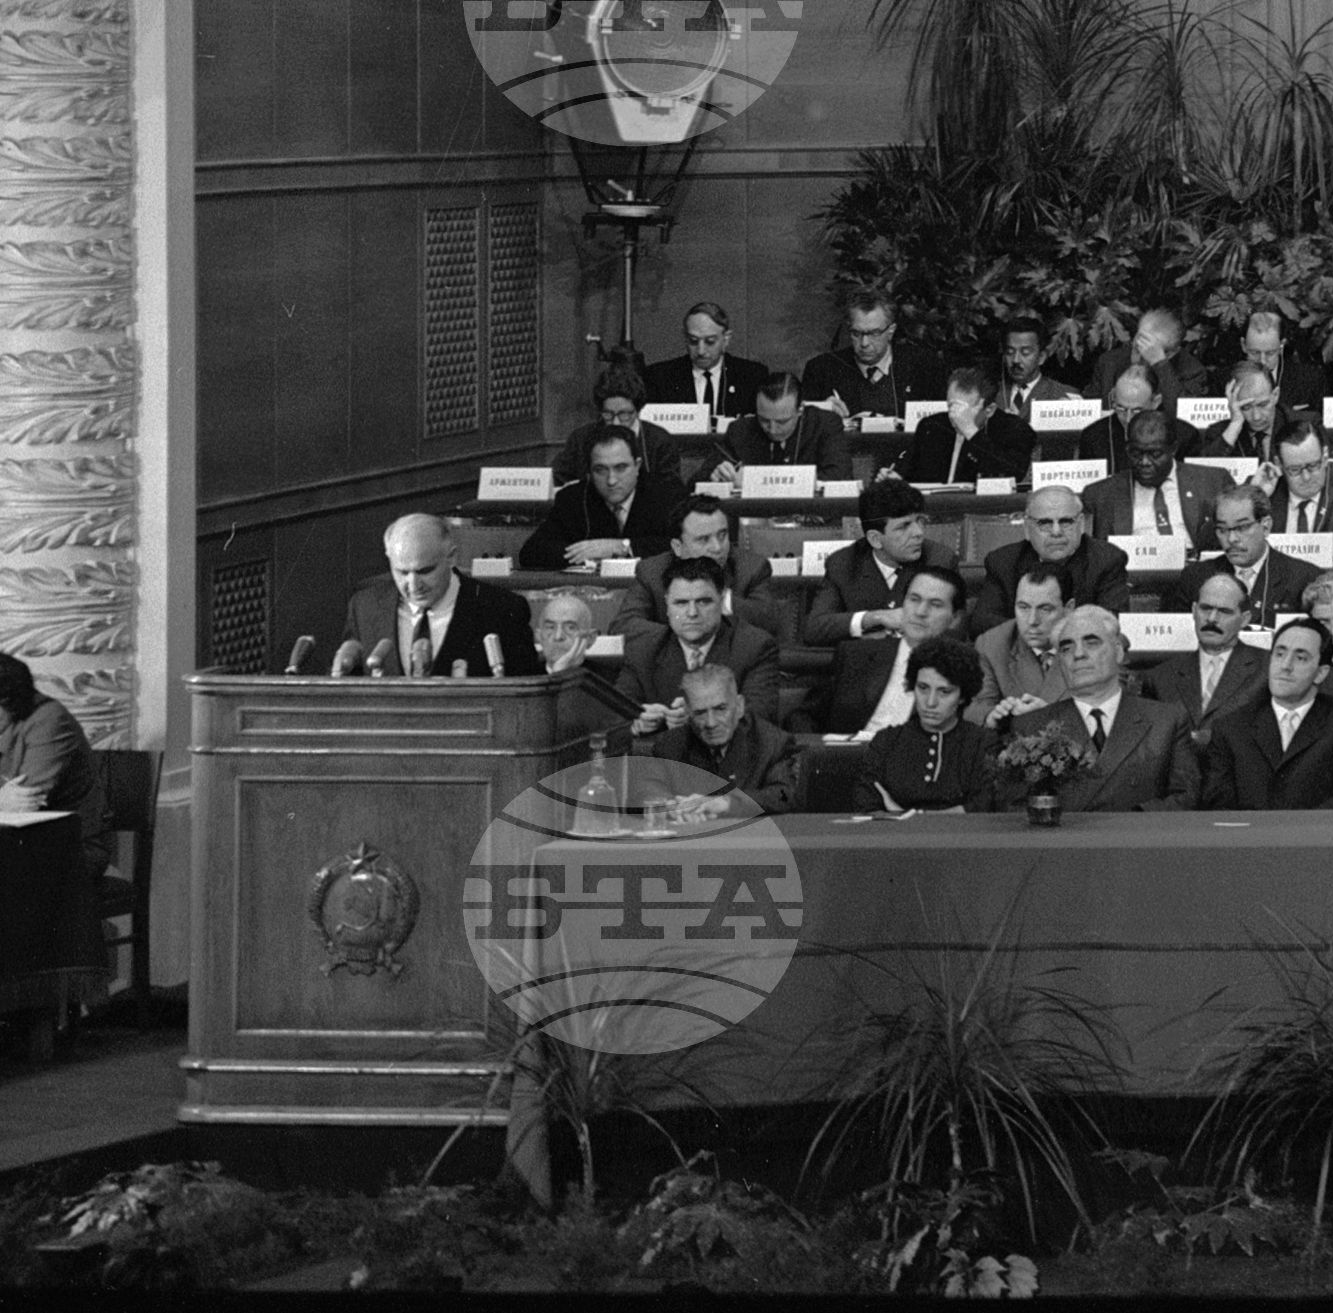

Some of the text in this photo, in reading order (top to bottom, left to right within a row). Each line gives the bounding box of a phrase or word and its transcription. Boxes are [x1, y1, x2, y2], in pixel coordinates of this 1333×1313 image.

[1039, 407, 1093, 418] ШВЕЙЦАРИЯ
[762, 476, 795, 486] ДАНИЯ
[1040, 470, 1100, 481] ПОРТУГАЛИЯ
[489, 478, 541, 487] АРЖЕНТИНА
[1134, 546, 1158, 557] САЩ
[1144, 625, 1173, 636] КУБА
